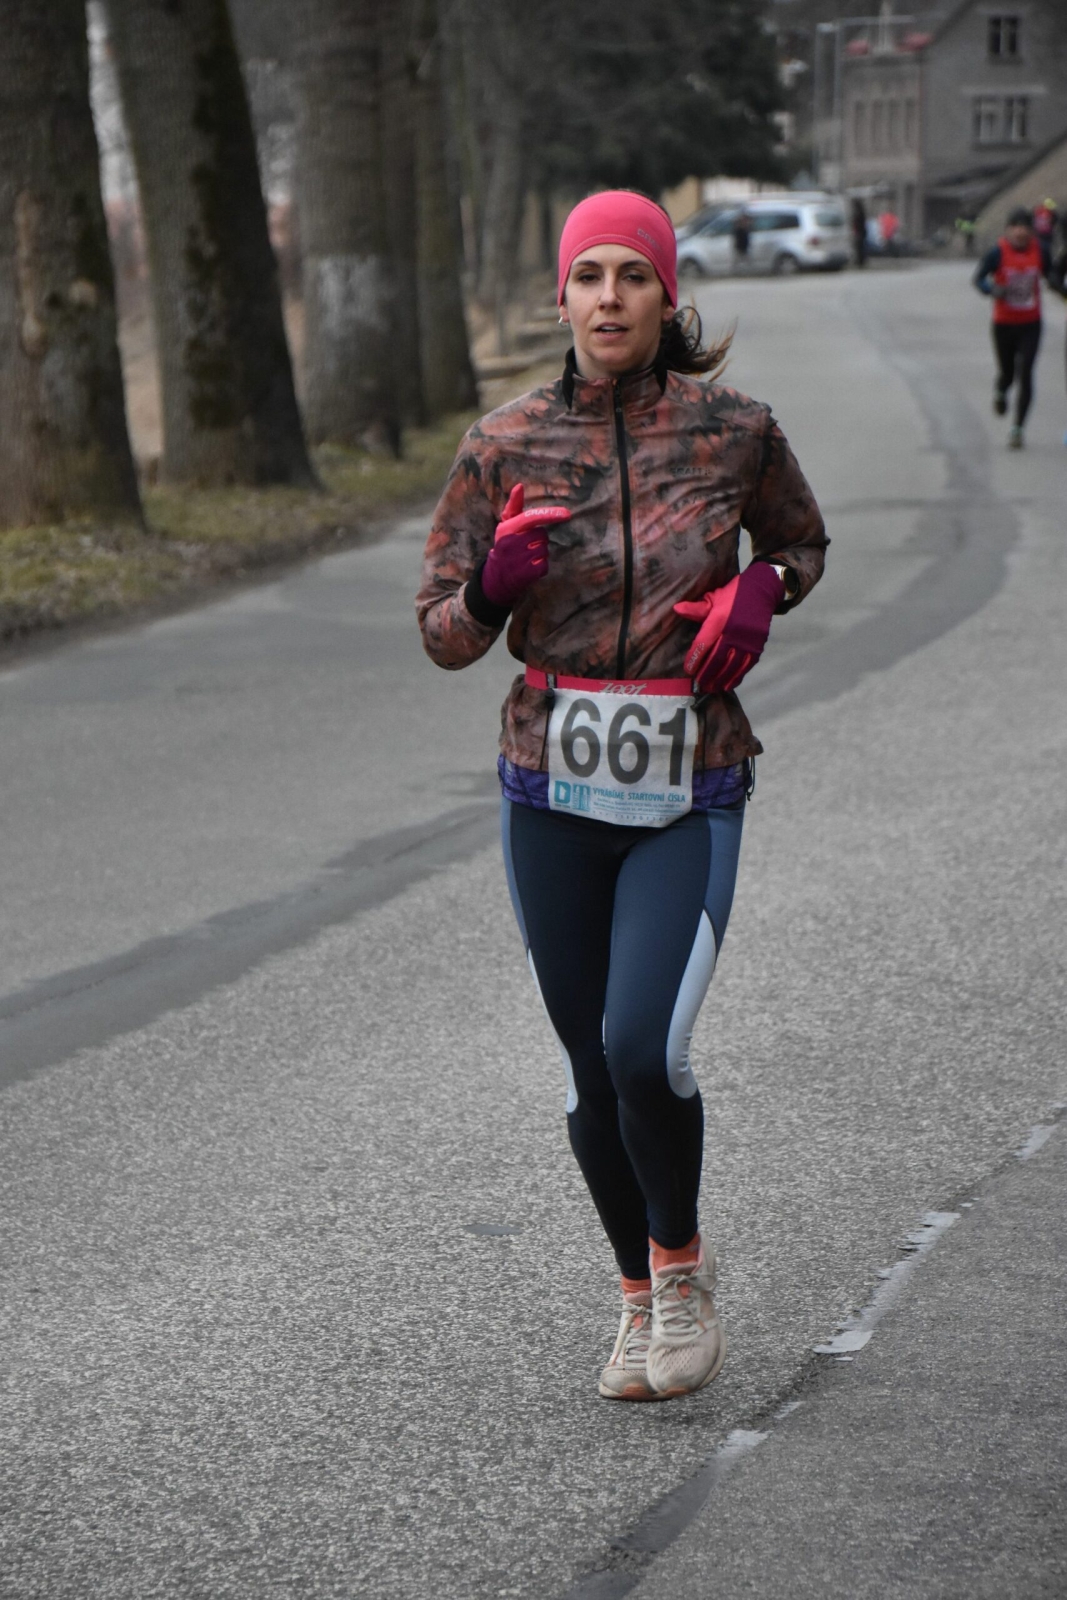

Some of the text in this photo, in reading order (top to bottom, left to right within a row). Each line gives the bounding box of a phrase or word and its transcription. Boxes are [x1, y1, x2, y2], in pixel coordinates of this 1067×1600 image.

[560, 698, 687, 786] 661
[628, 792, 665, 802] STARTOVNÍ
[668, 792, 686, 803] ČÍSLA
